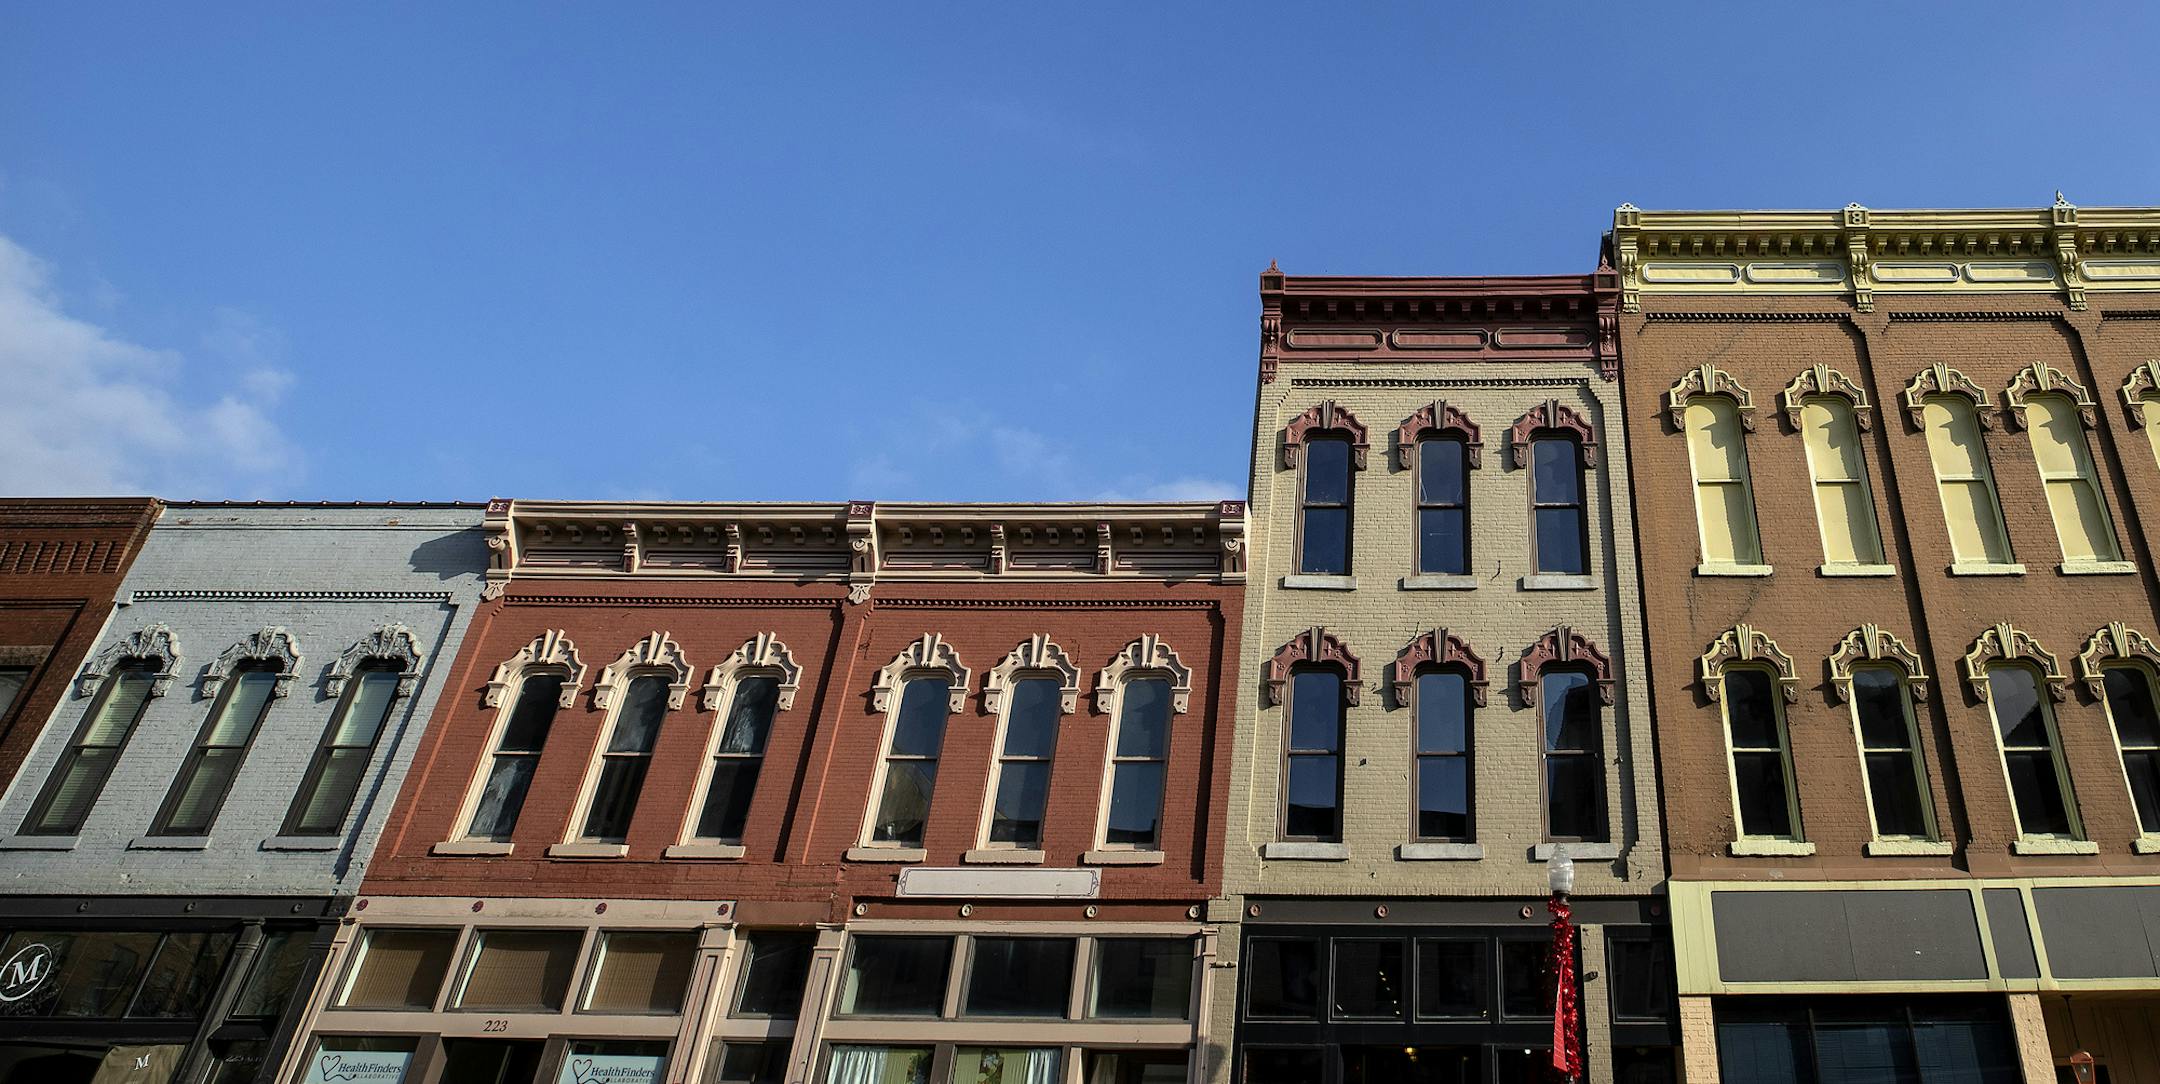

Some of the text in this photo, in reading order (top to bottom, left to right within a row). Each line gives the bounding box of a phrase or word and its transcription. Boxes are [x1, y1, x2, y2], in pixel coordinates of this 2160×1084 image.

[1852, 211, 1862, 225] 8
[6, 953, 45, 990] M
[483, 1020, 508, 1032] 223
[134, 1053, 151, 1071] M
